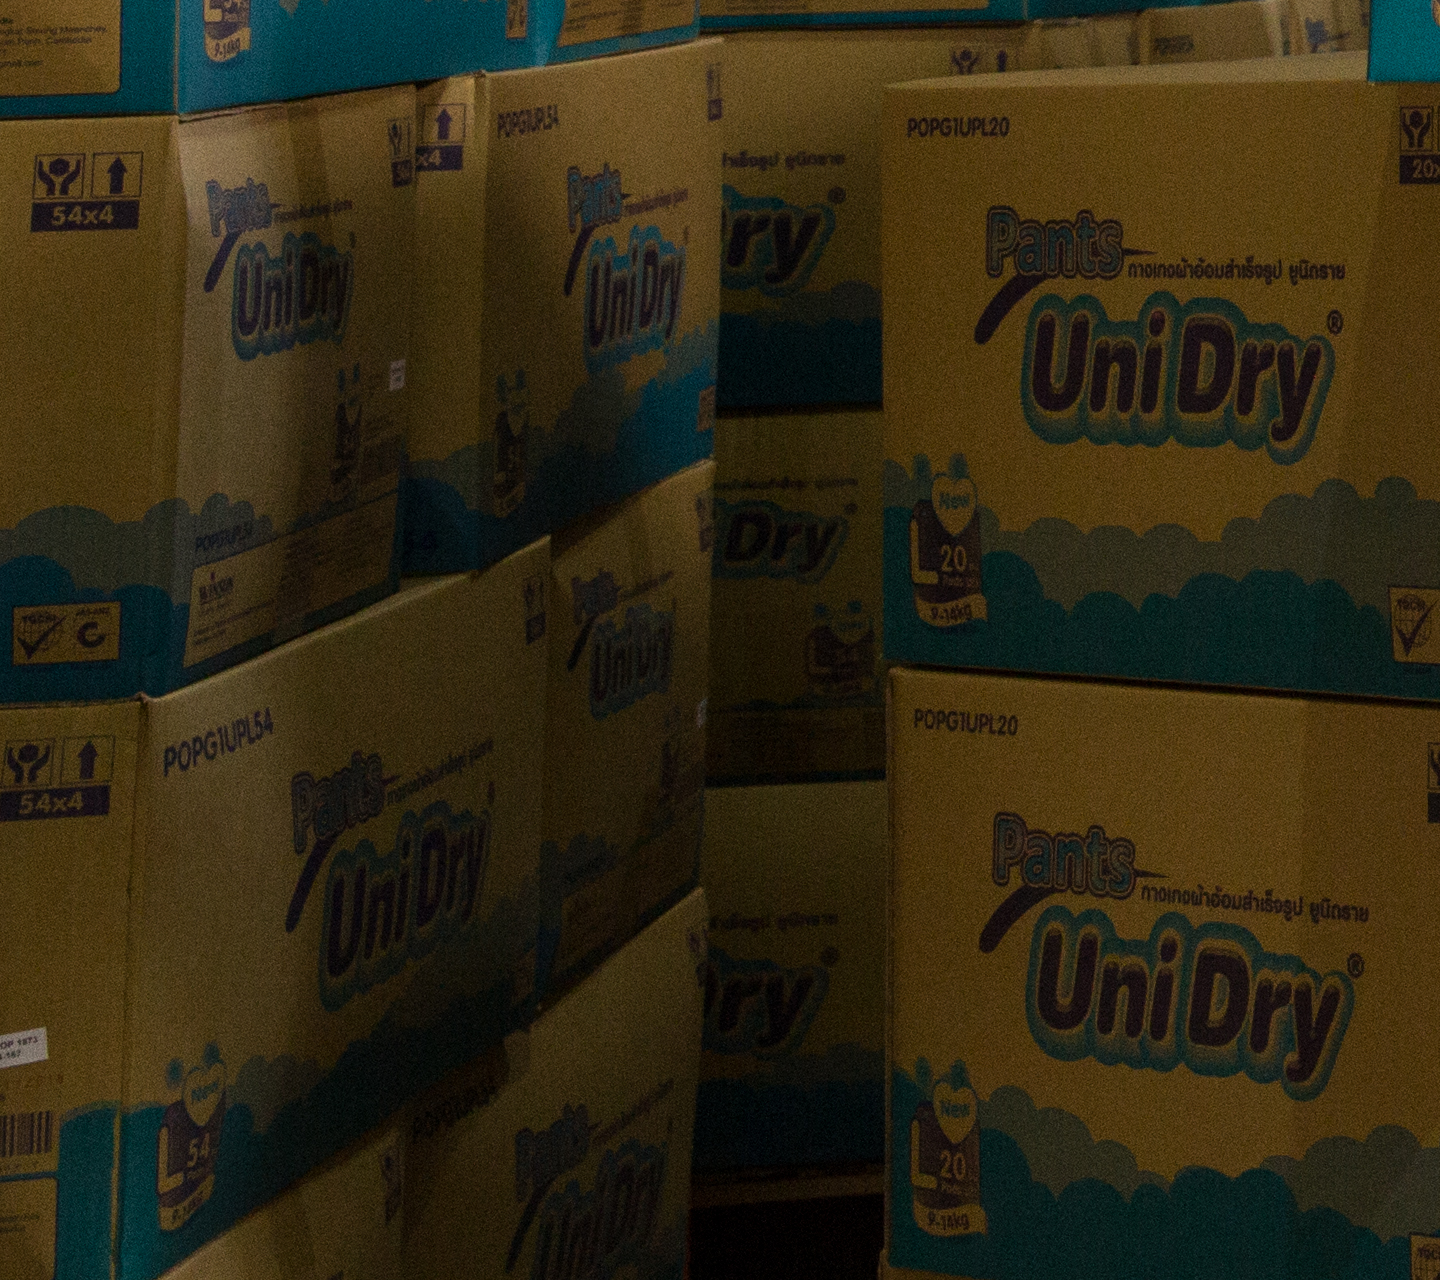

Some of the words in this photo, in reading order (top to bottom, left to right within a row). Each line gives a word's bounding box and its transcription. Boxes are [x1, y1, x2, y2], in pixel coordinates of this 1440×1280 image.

[907, 116, 1010, 138] POPG1UPL20
[50, 204, 116, 227] 54x4
[986, 205, 1124, 279] Pants
[913, 708, 1019, 738] POPG1UPL20
[163, 708, 274, 778] POPG1UPL54
[17, 788, 85, 814] 54x4
[992, 811, 1136, 900] Pants
